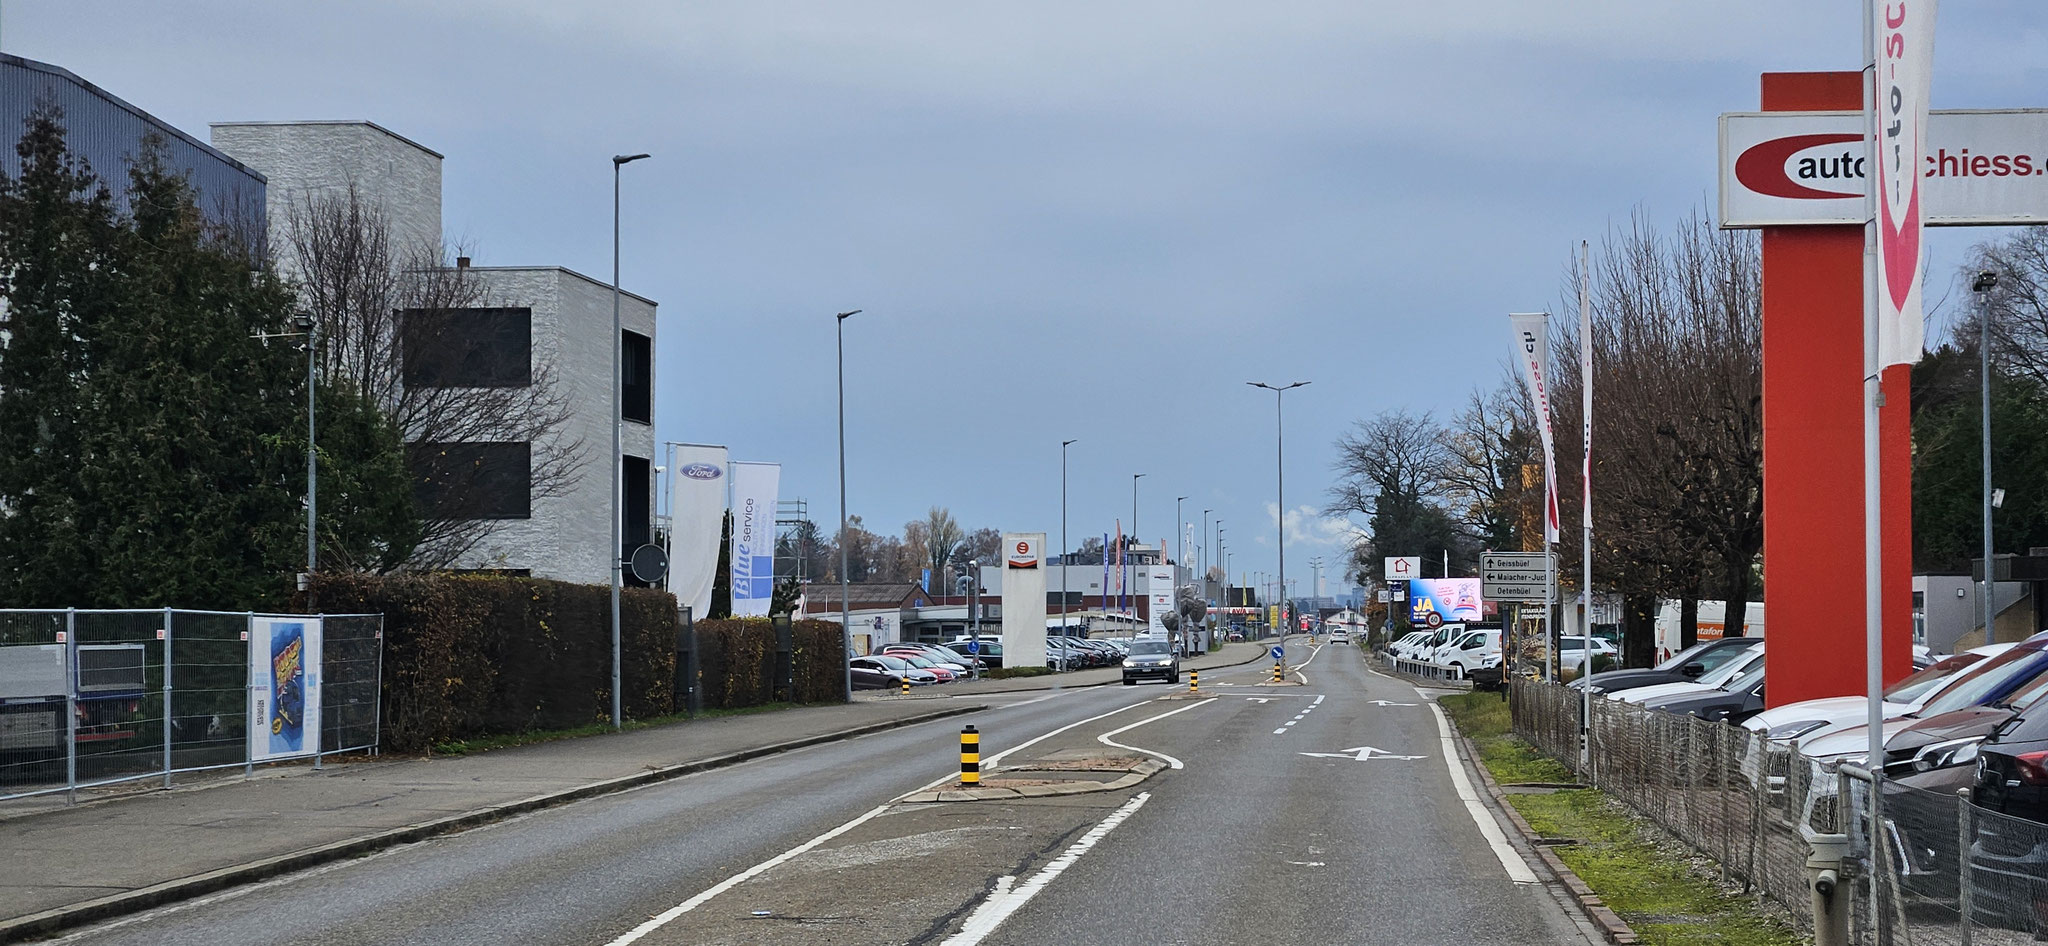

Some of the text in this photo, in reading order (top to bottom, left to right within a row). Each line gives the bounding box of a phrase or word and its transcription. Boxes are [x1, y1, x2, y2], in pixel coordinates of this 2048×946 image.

[688, 464, 715, 478] Ford
[735, 498, 754, 597] Blue service
[1413, 598, 1434, 612] JA
